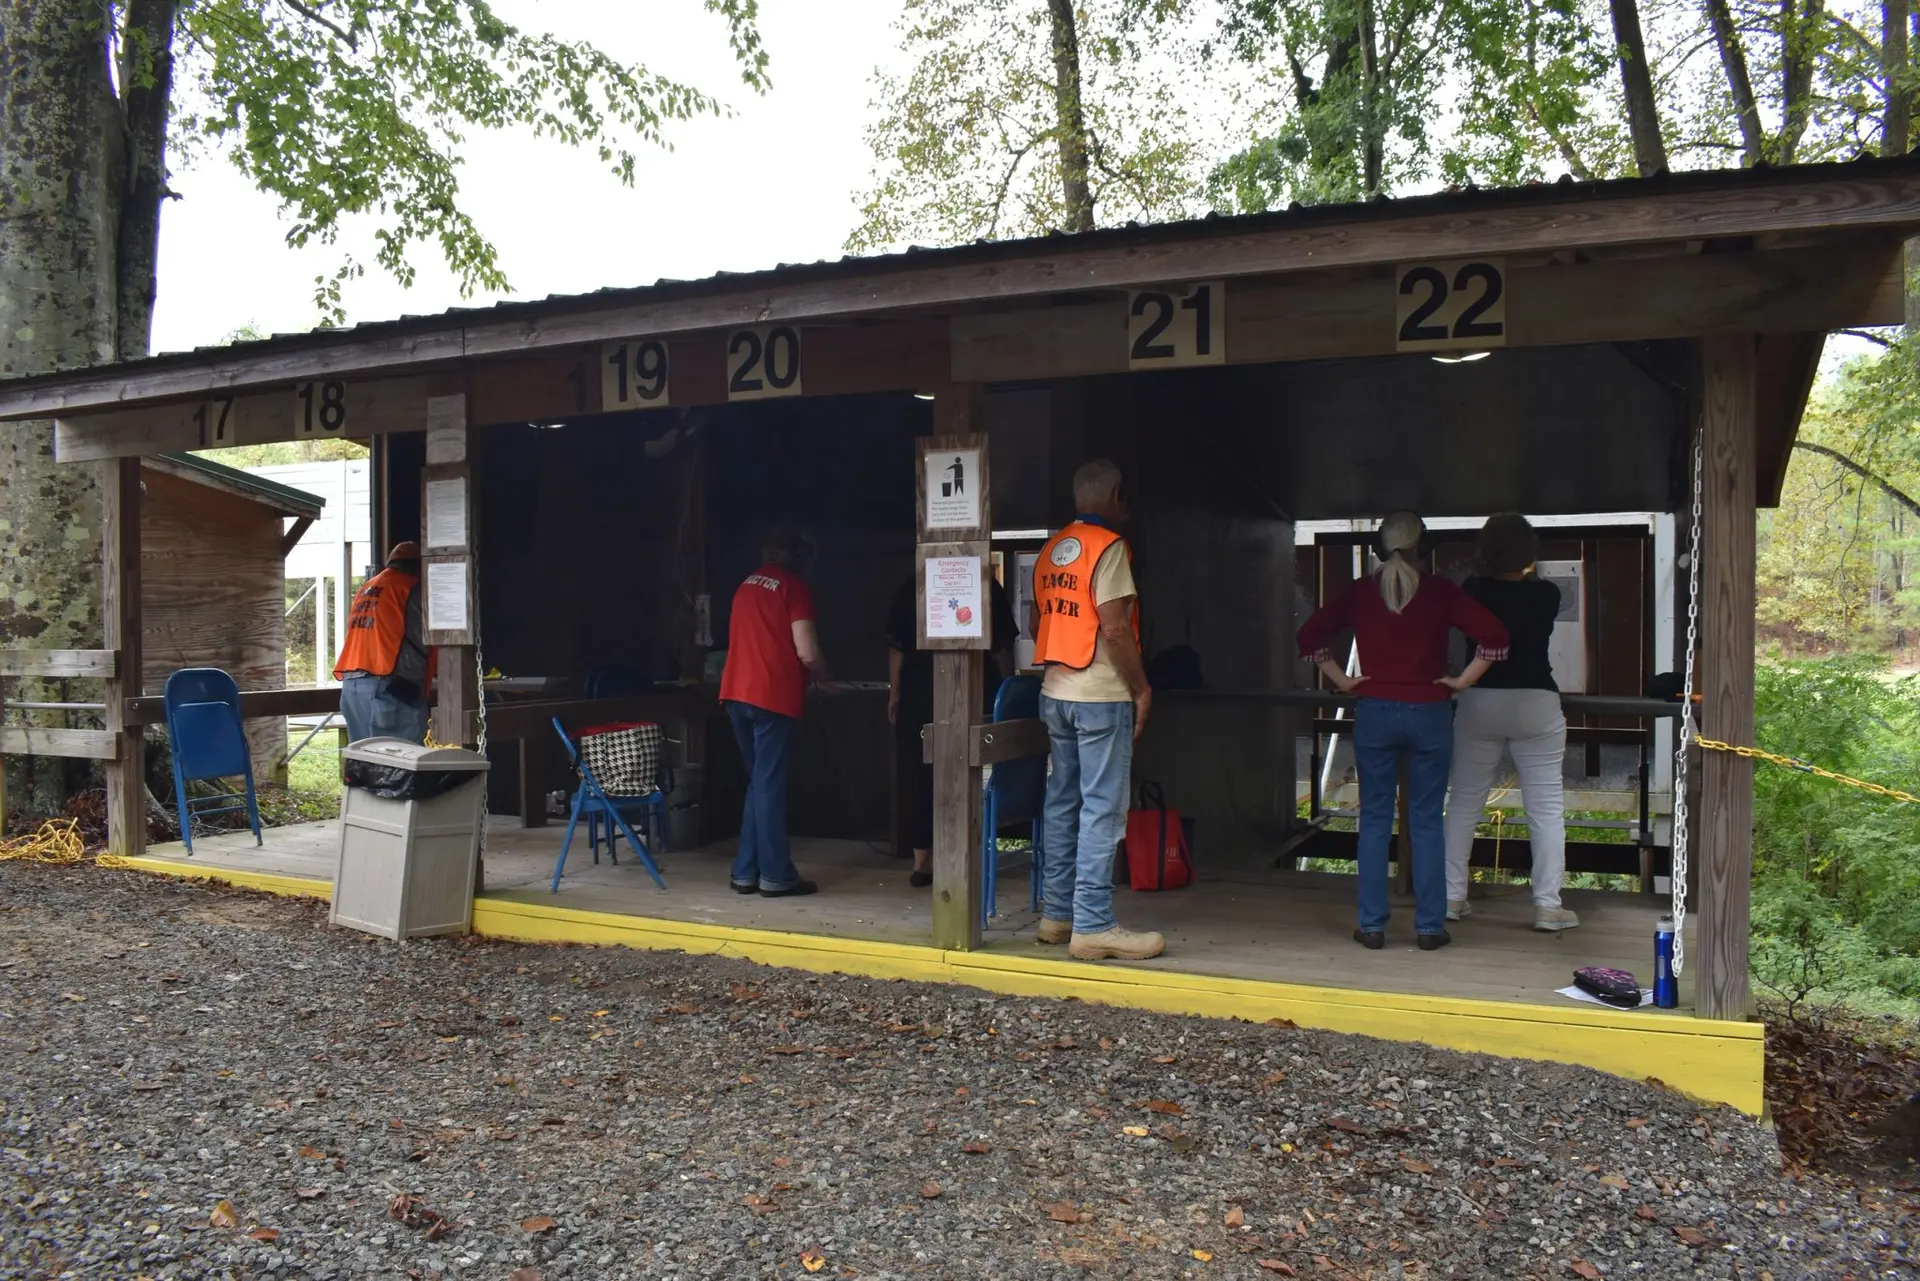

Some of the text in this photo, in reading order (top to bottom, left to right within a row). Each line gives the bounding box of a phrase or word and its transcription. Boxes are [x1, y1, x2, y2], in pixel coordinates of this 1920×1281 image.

[1130, 285, 1210, 360] 21
[1398, 262, 1503, 342] 22
[608, 341, 668, 403] 19
[728, 326, 800, 394] 20
[192, 395, 235, 446] 17
[298, 381, 346, 432] 18
